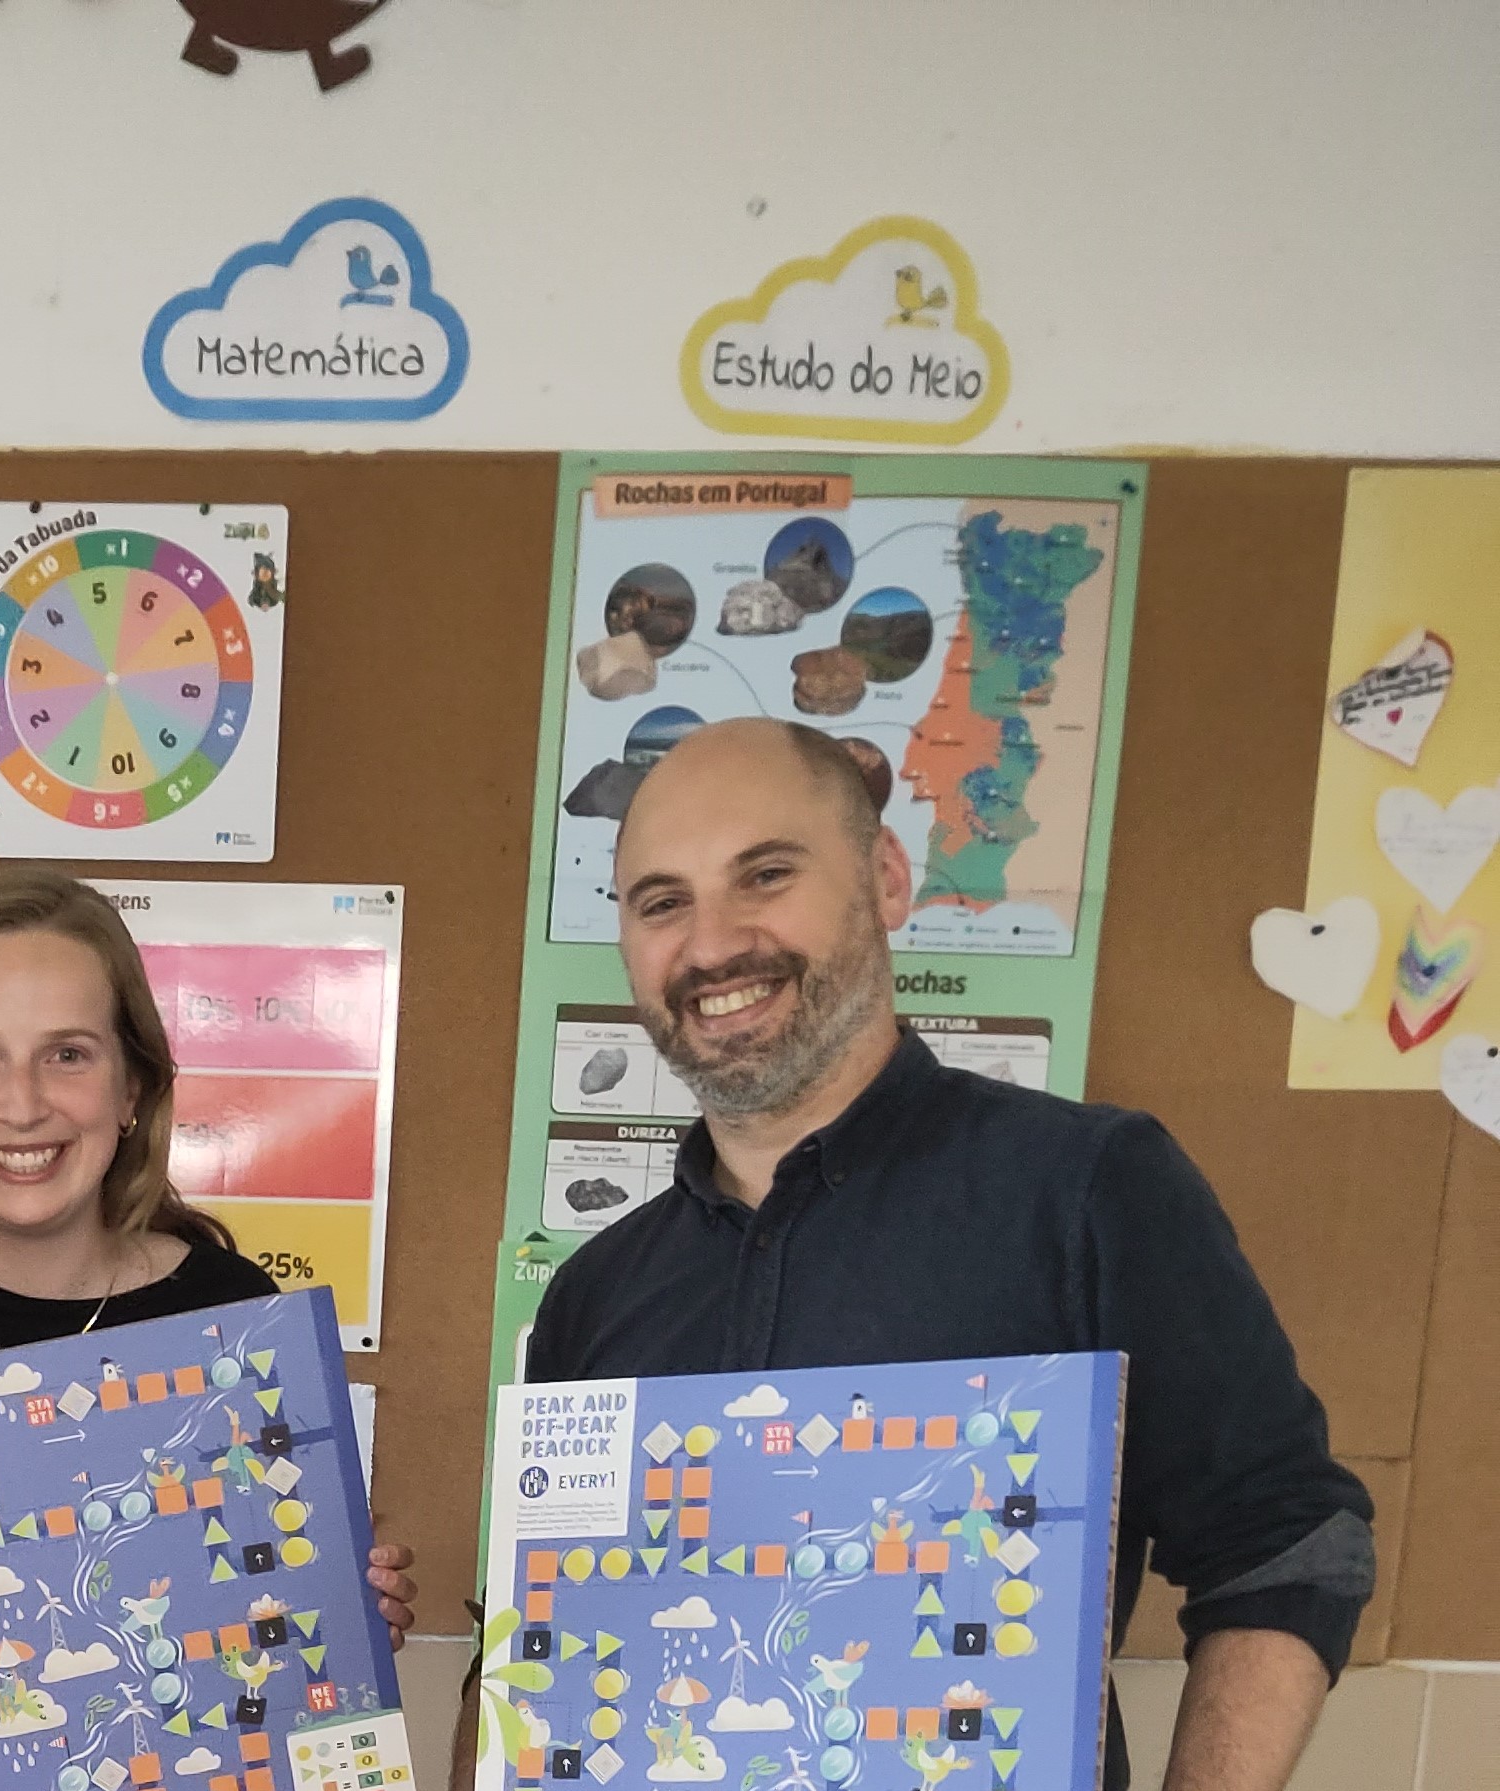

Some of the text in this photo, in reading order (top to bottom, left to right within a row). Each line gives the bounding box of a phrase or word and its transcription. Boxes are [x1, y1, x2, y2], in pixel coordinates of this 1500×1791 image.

[197, 332, 424, 376] Matemática
[713, 340, 982, 400] Estudo do Meio
[616, 480, 828, 508] Rochas em Portugal
[13, 509, 97, 554] Tabuada
[92, 582, 107, 605] 5
[141, 591, 158, 611] 6
[22, 659, 42, 674] 3
[181, 683, 200, 698] 8
[895, 970, 967, 995] ochas
[617, 1126, 677, 1139] DUREZA
[258, 1252, 314, 1279] 25%
[523, 1392, 627, 1416] PEAK AND
[522, 1415, 617, 1437] OFF-PEAK
[521, 1438, 611, 1458] PEACOCK
